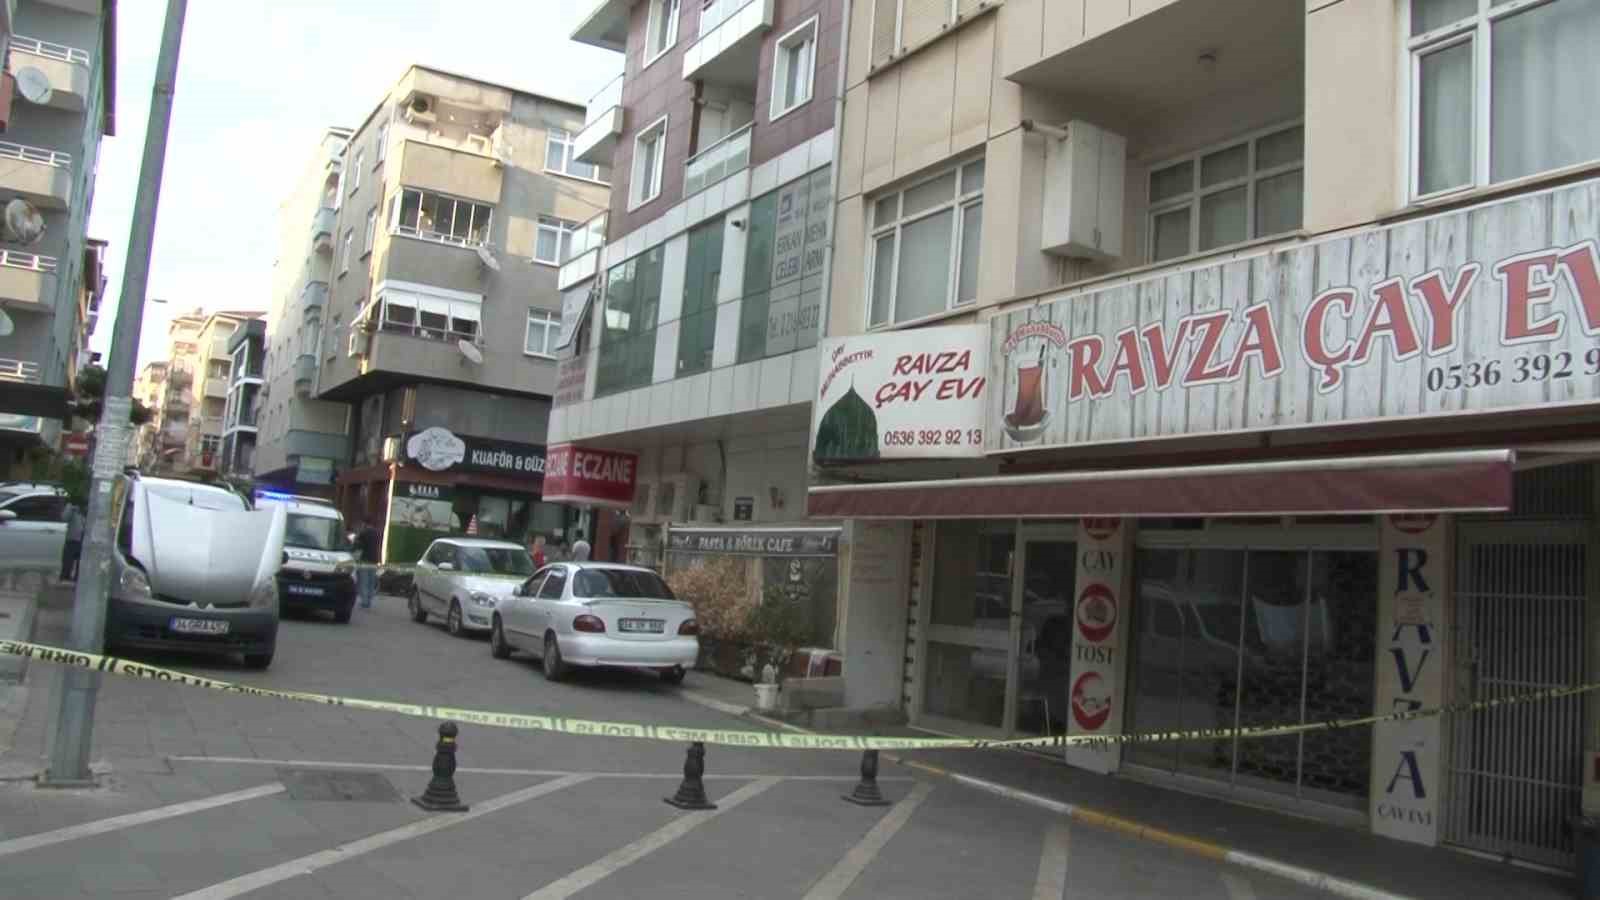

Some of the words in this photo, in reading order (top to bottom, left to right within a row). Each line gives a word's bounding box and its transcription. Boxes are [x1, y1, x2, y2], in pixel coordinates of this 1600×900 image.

[1068, 303, 1283, 398] RAVZA
[1302, 263, 1479, 391] ÇAY
[893, 350, 971, 376] RAVZA
[1427, 359, 1501, 391] 0536
[1512, 352, 1573, 383] 392
[874, 379, 933, 408] ÇAY
[884, 431, 914, 446] 0536
[918, 430, 942, 445] 392
[945, 430, 961, 444] 92
[967, 429, 982, 444] 13
[471, 449, 514, 468] KUAFÖR
[515, 457, 523, 470] &
[573, 452, 633, 484] ECZANE
[767, 538, 793, 552] CAFE
[1077, 645, 1113, 665] TOST
